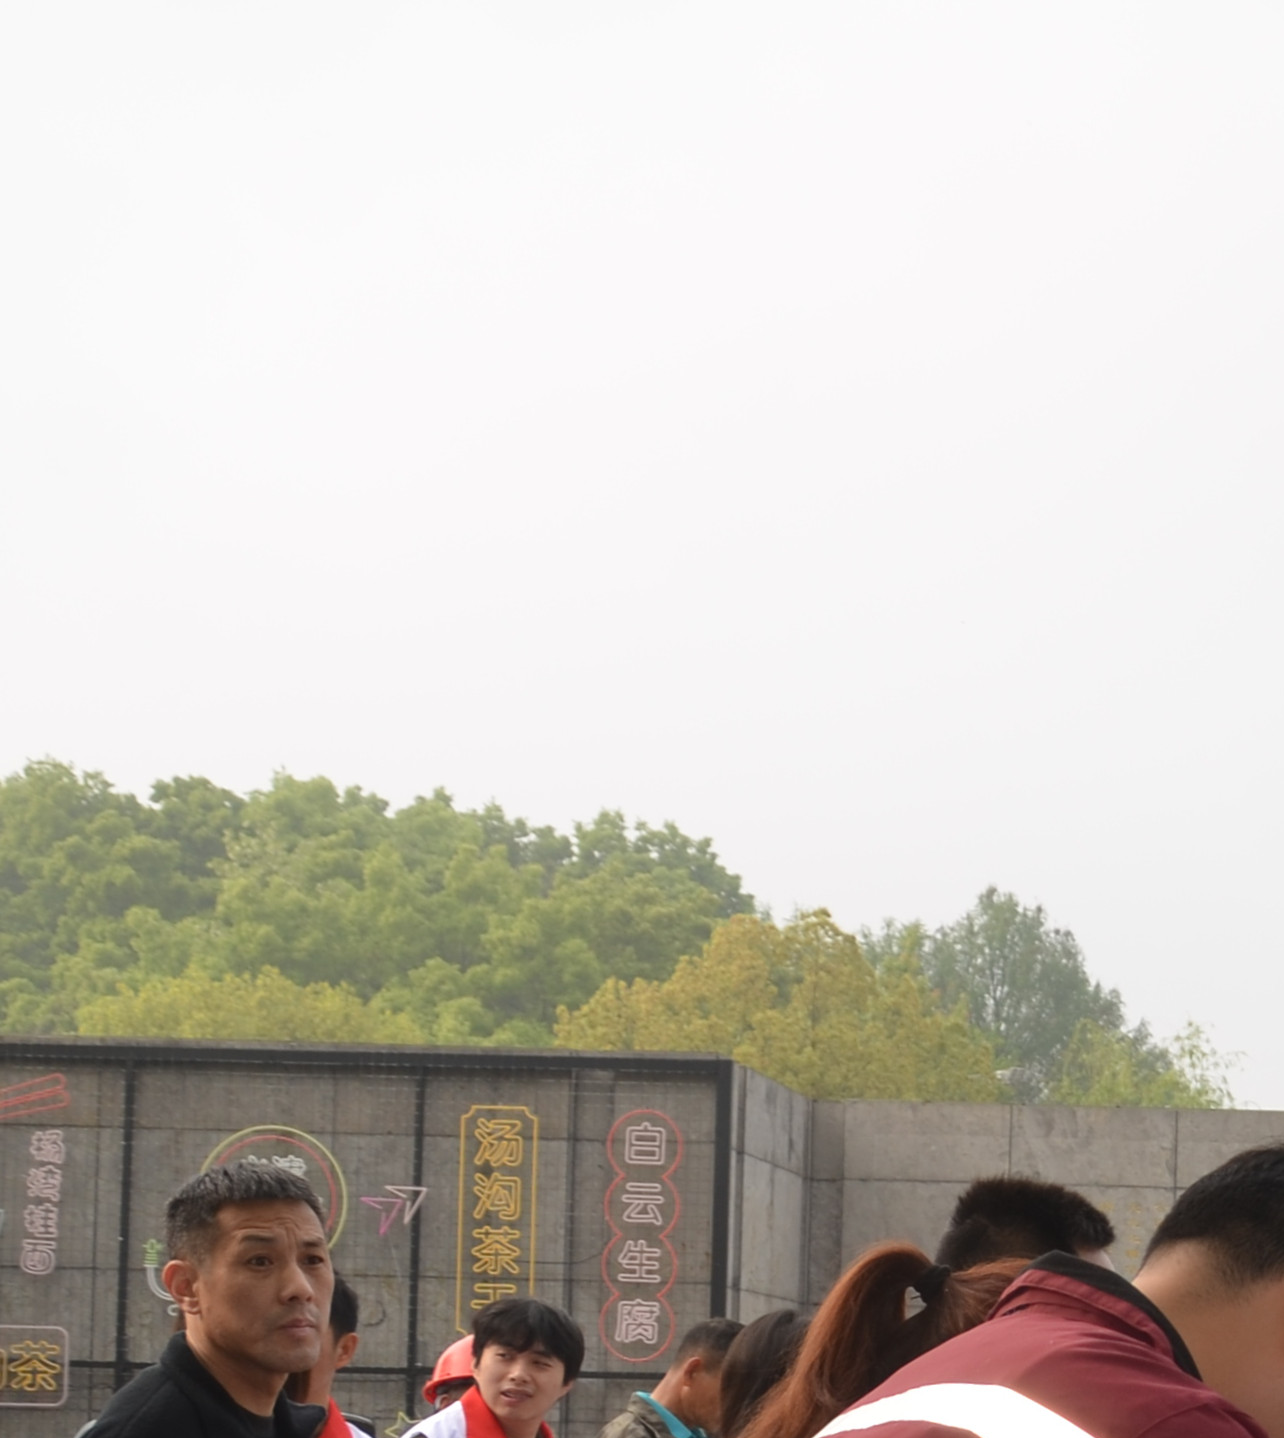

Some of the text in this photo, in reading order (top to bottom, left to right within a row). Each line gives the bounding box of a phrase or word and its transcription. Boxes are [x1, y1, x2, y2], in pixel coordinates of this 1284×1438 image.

[615, 1122, 668, 1344] 白云生腐
[0, 1340, 61, 1392] 茶
